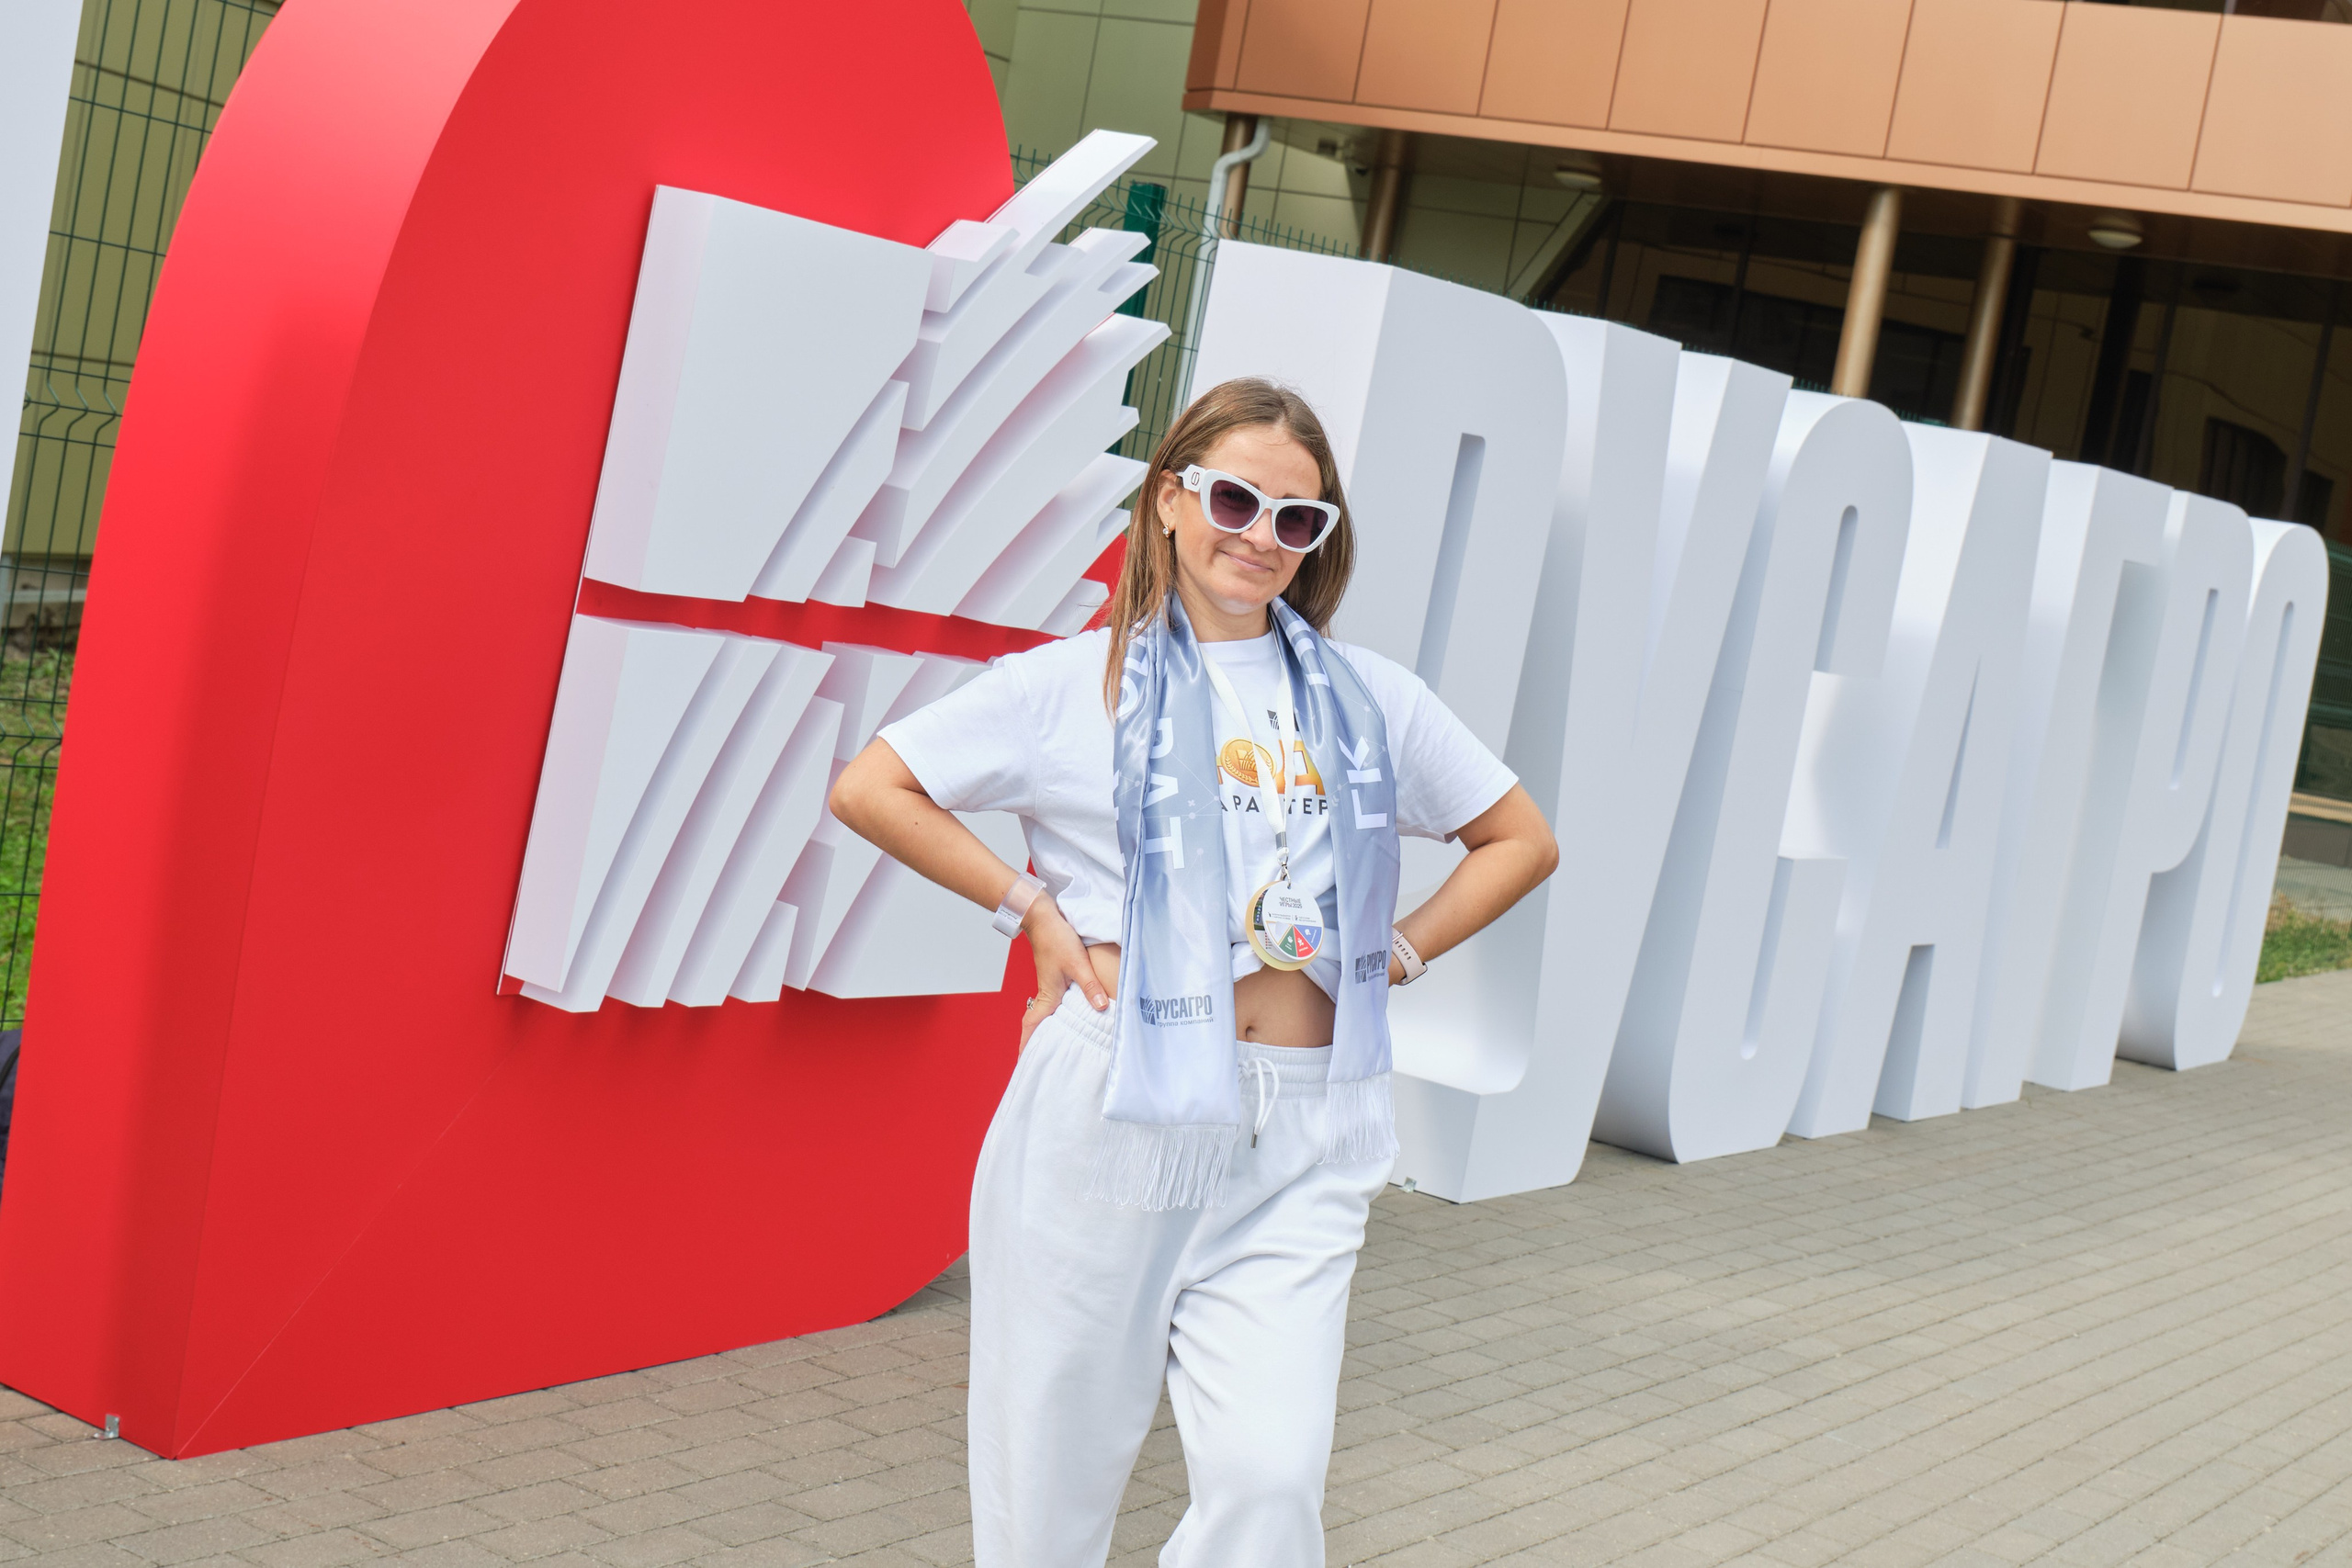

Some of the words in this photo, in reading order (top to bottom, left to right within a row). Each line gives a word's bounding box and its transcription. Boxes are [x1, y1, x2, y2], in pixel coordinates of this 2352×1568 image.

[1194, 240, 2330, 1204] РУСАГРО
[1336, 735, 1387, 830] ГК
[1154, 994, 1213, 1020] РУСАГРО
[1180, 1016, 1215, 1026] компаний
